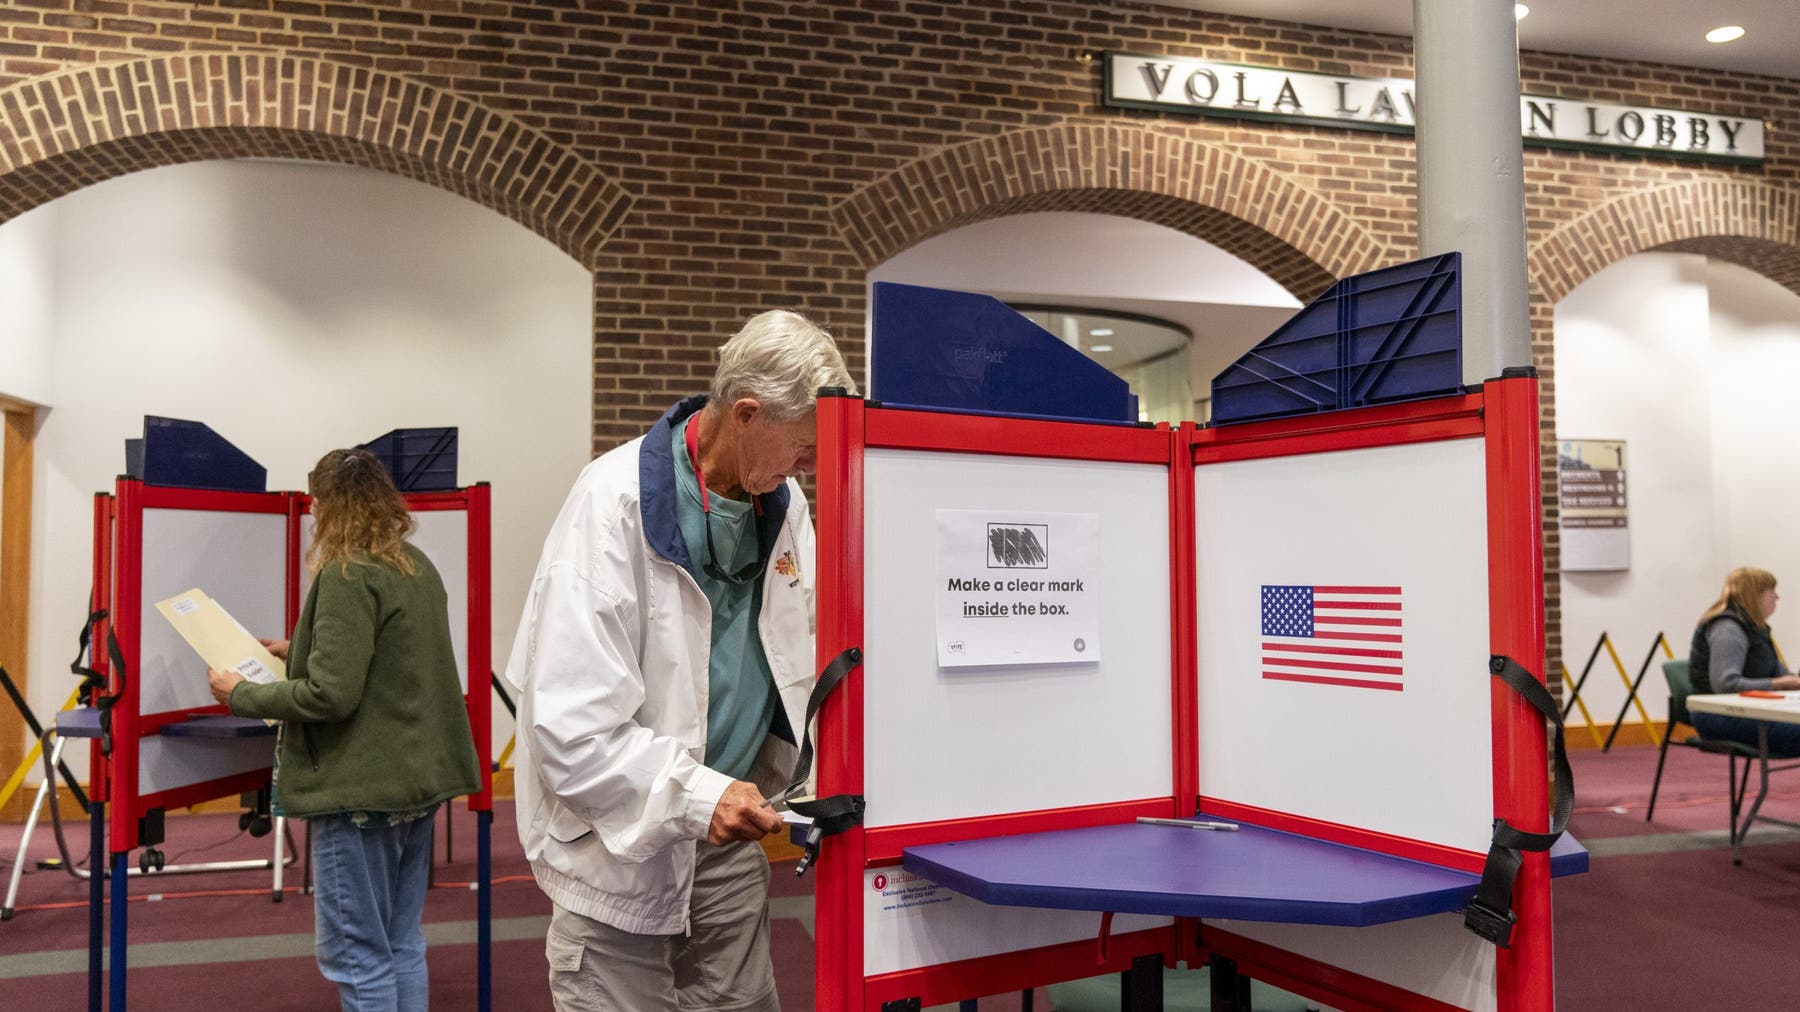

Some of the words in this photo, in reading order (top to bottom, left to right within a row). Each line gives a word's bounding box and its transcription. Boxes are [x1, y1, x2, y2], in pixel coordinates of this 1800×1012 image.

[1142, 61, 1304, 110] VOLA
[1585, 106, 1744, 150] LOBBY
[1615, 446, 1623, 467] 1
[948, 578, 991, 592] Make
[994, 581, 1004, 592] a
[1007, 579, 1045, 592] clear
[1048, 579, 1084, 592] mark
[963, 601, 1009, 616] inside
[1012, 602, 1036, 616] the
[1039, 602, 1069, 615] box.
